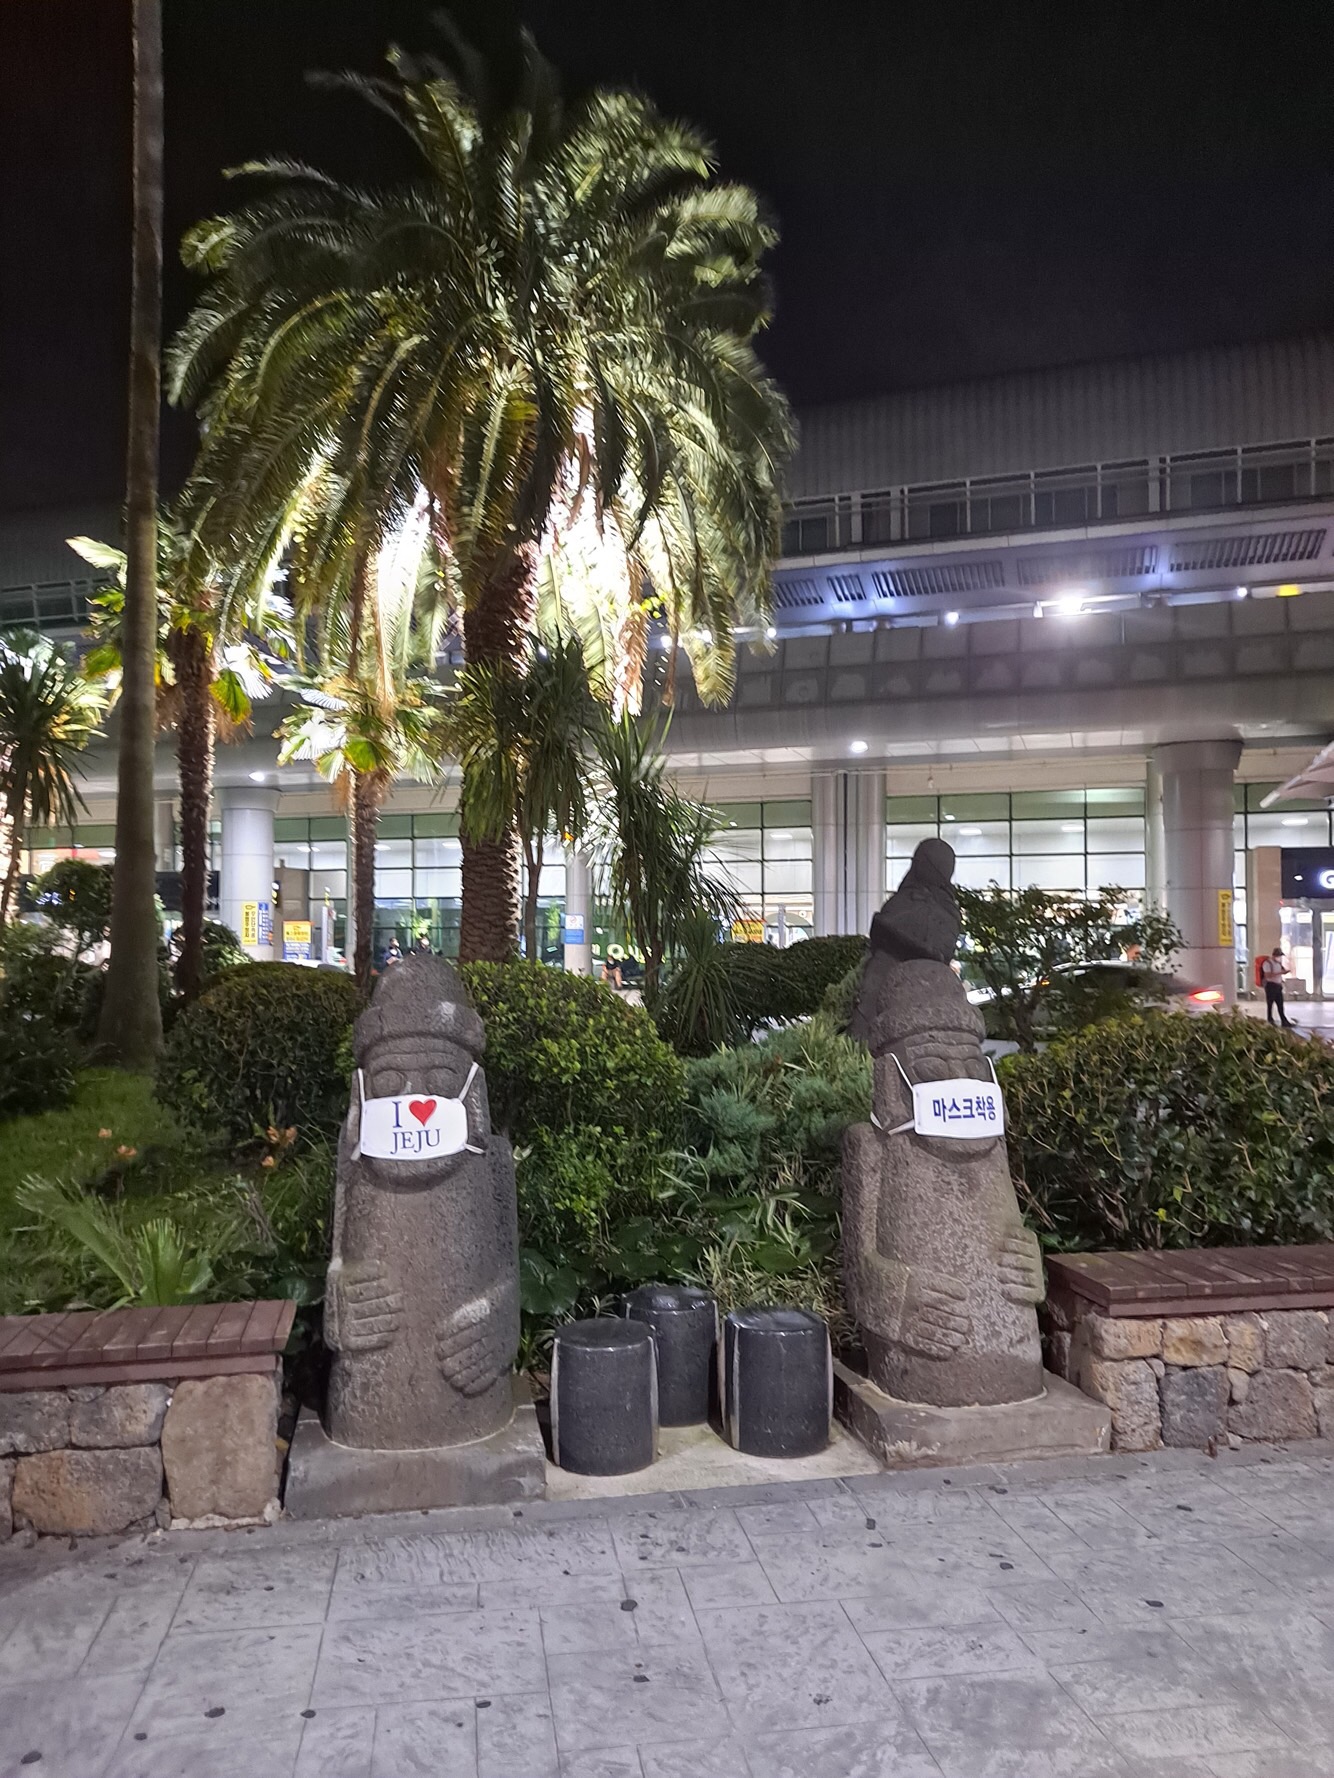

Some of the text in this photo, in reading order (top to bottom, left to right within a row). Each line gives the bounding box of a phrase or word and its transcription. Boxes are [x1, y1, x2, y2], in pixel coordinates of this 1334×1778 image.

[392, 1101, 402, 1128] I
[932, 1095, 997, 1123] 마스크착용
[390, 1128, 441, 1155] JEJU
